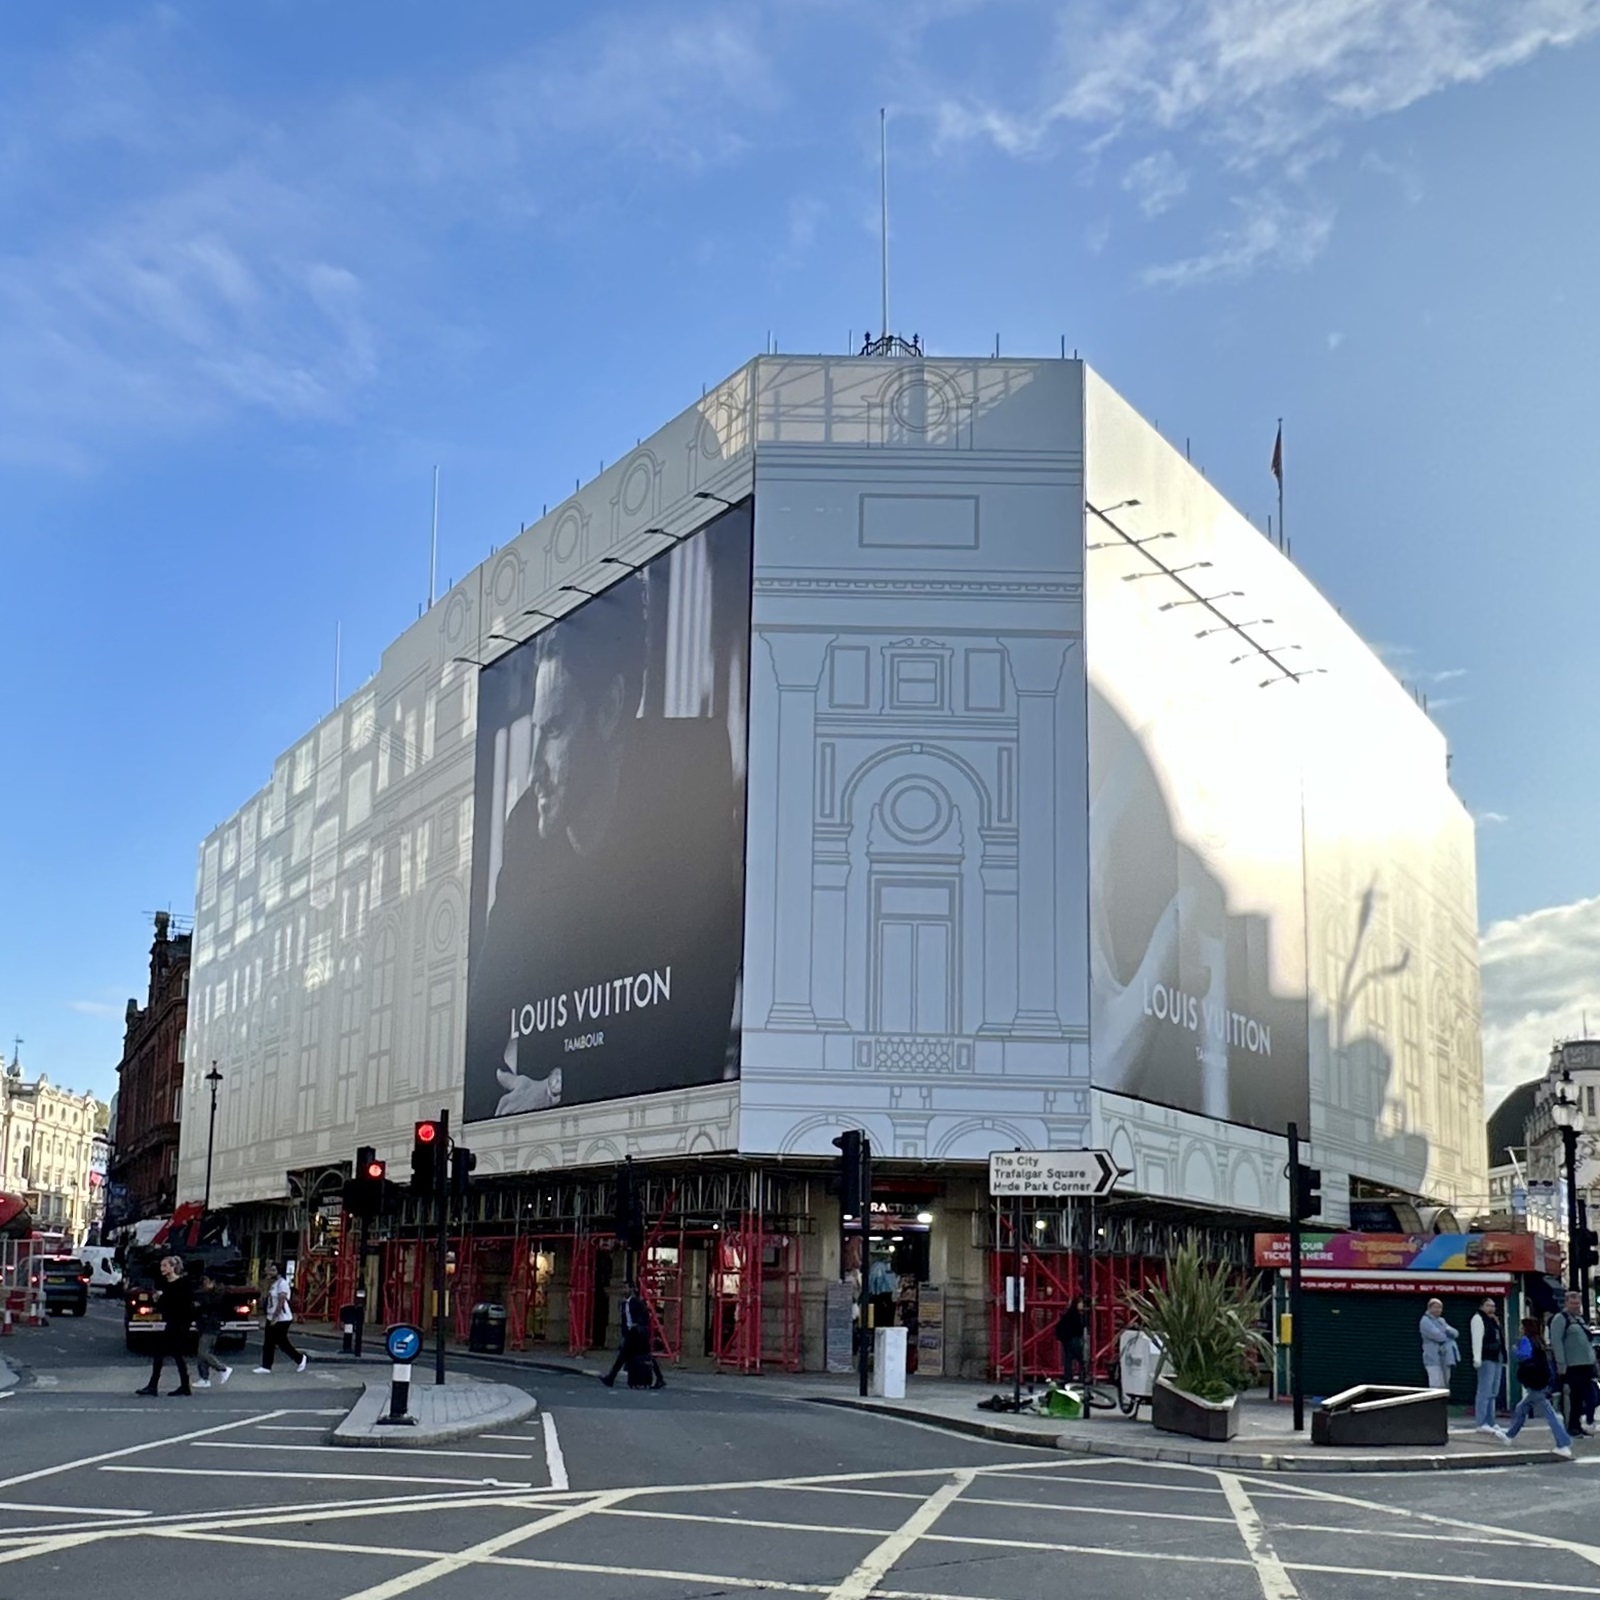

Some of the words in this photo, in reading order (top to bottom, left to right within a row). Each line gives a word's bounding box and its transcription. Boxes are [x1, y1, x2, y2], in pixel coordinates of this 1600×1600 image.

[511, 994, 567, 1039] LOUIS
[573, 966, 671, 1022] VUITTON
[1144, 978, 1198, 1031] LOUIS
[1202, 998, 1271, 1057] VUITTON
[563, 1031, 604, 1052] TAMBOUR
[995, 1156, 1013, 1166] The
[1017, 1155, 1039, 1167] City
[994, 1168, 1042, 1180] Trafalgar
[1047, 1168, 1086, 1180] Square
[1024, 1181, 1048, 1191] Park
[1053, 1181, 1091, 1191] Corner
[1272, 1241, 1292, 1251] BUY
[1299, 1242, 1324, 1251] OUR
[1306, 1252, 1334, 1261] HERE
